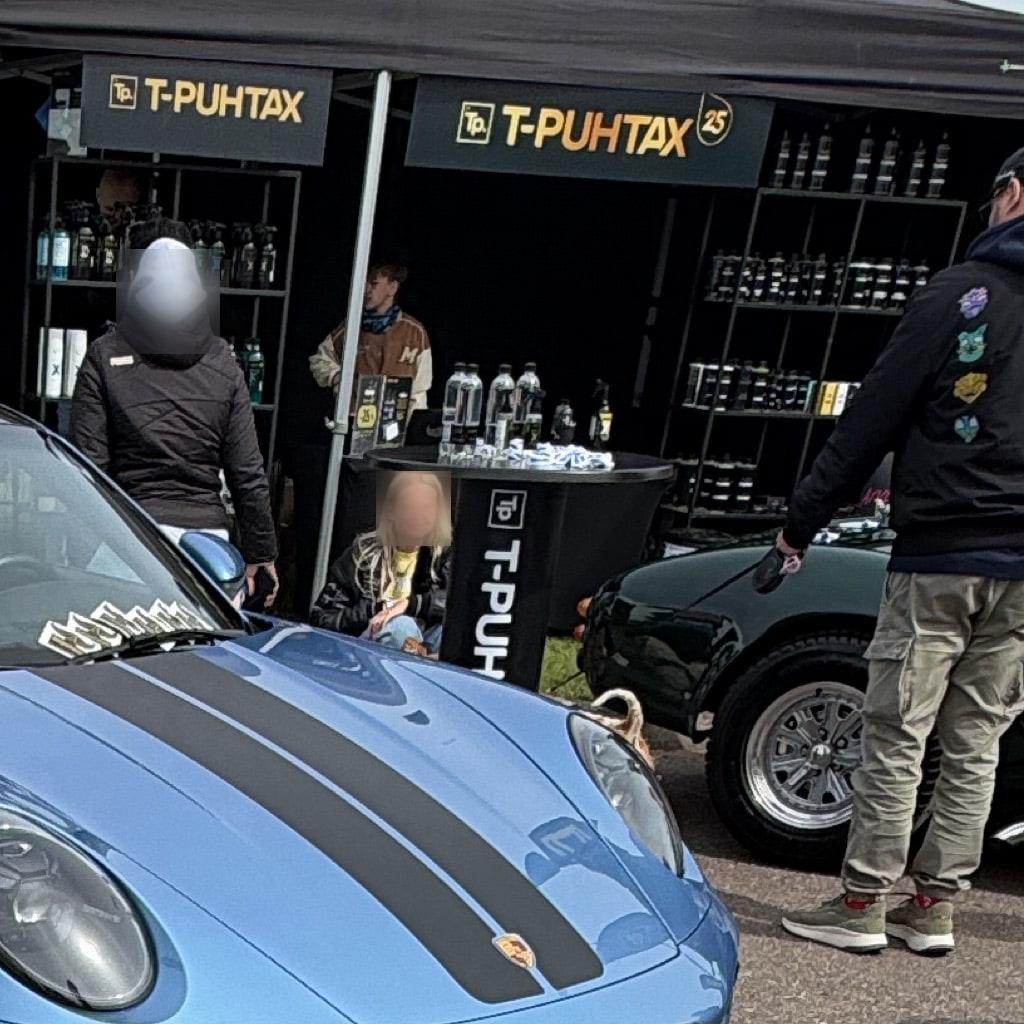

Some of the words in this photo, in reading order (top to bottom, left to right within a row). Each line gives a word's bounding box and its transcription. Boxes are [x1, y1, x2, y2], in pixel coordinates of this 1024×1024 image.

[144, 77, 305, 123] T-PUHTAX
[703, 109, 729, 135] 25
[501, 104, 694, 158] T-PUHTAX
